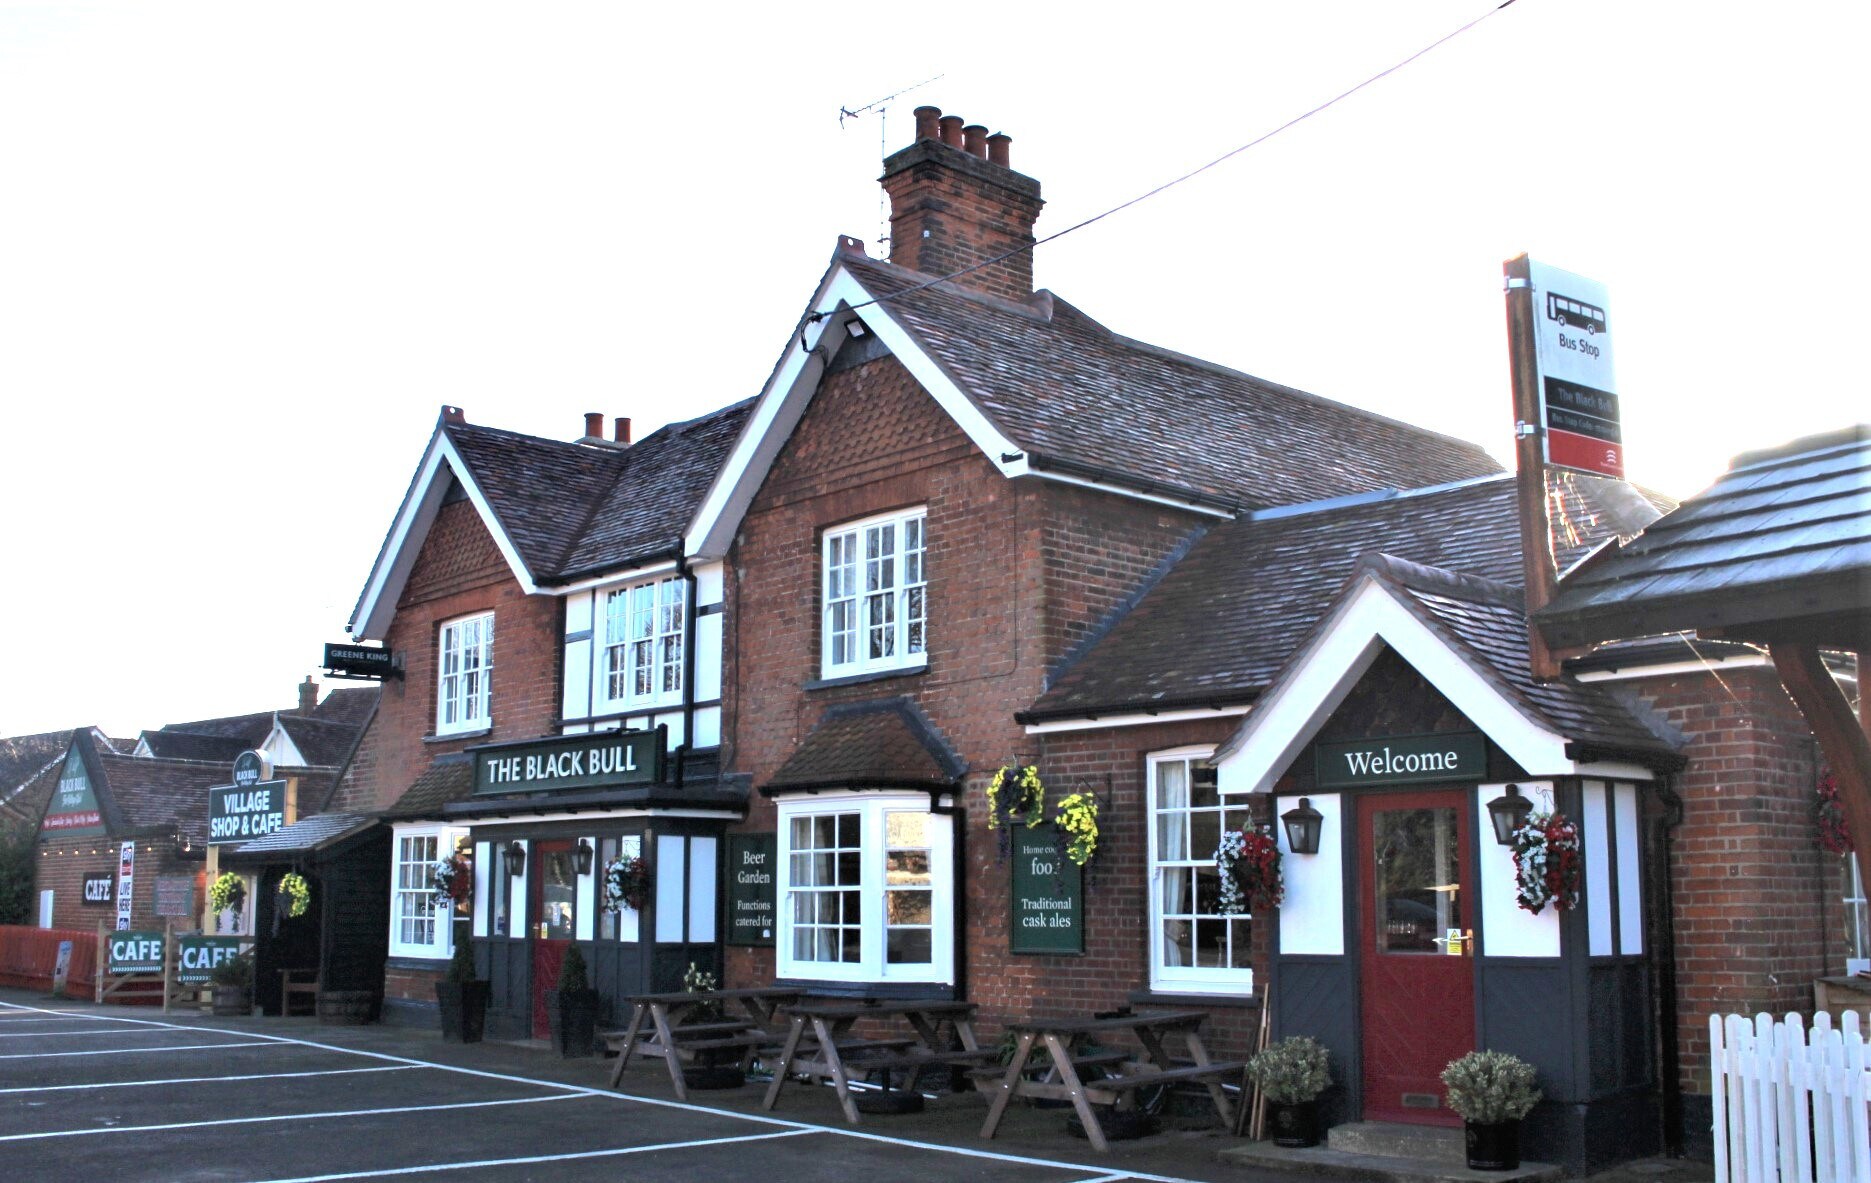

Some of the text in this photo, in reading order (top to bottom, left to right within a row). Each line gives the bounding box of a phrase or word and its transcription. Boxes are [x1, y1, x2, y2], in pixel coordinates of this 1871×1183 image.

[1559, 333, 1600, 360] Bus Stop
[331, 650, 365, 660] GREENE
[366, 653, 389, 662] KING
[487, 744, 636, 783] THE BLACK BULL
[1345, 748, 1458, 775] Welcome
[224, 790, 270, 814] VILLAGE
[211, 812, 282, 837] SHOP & CAFE
[1023, 845, 1044, 854] Home
[743, 850, 766, 865] Beer
[1031, 857, 1059, 875] foo
[738, 869, 770, 884] Garden
[85, 874, 112, 901] CAFÉ
[119, 882, 131, 896] LIVE
[737, 899, 771, 911] Functions
[1021, 897, 1072, 910] Traditional
[735, 915, 772, 927] catered for
[1022, 912, 1071, 927] cask ales
[112, 940, 161, 961] CAFE
